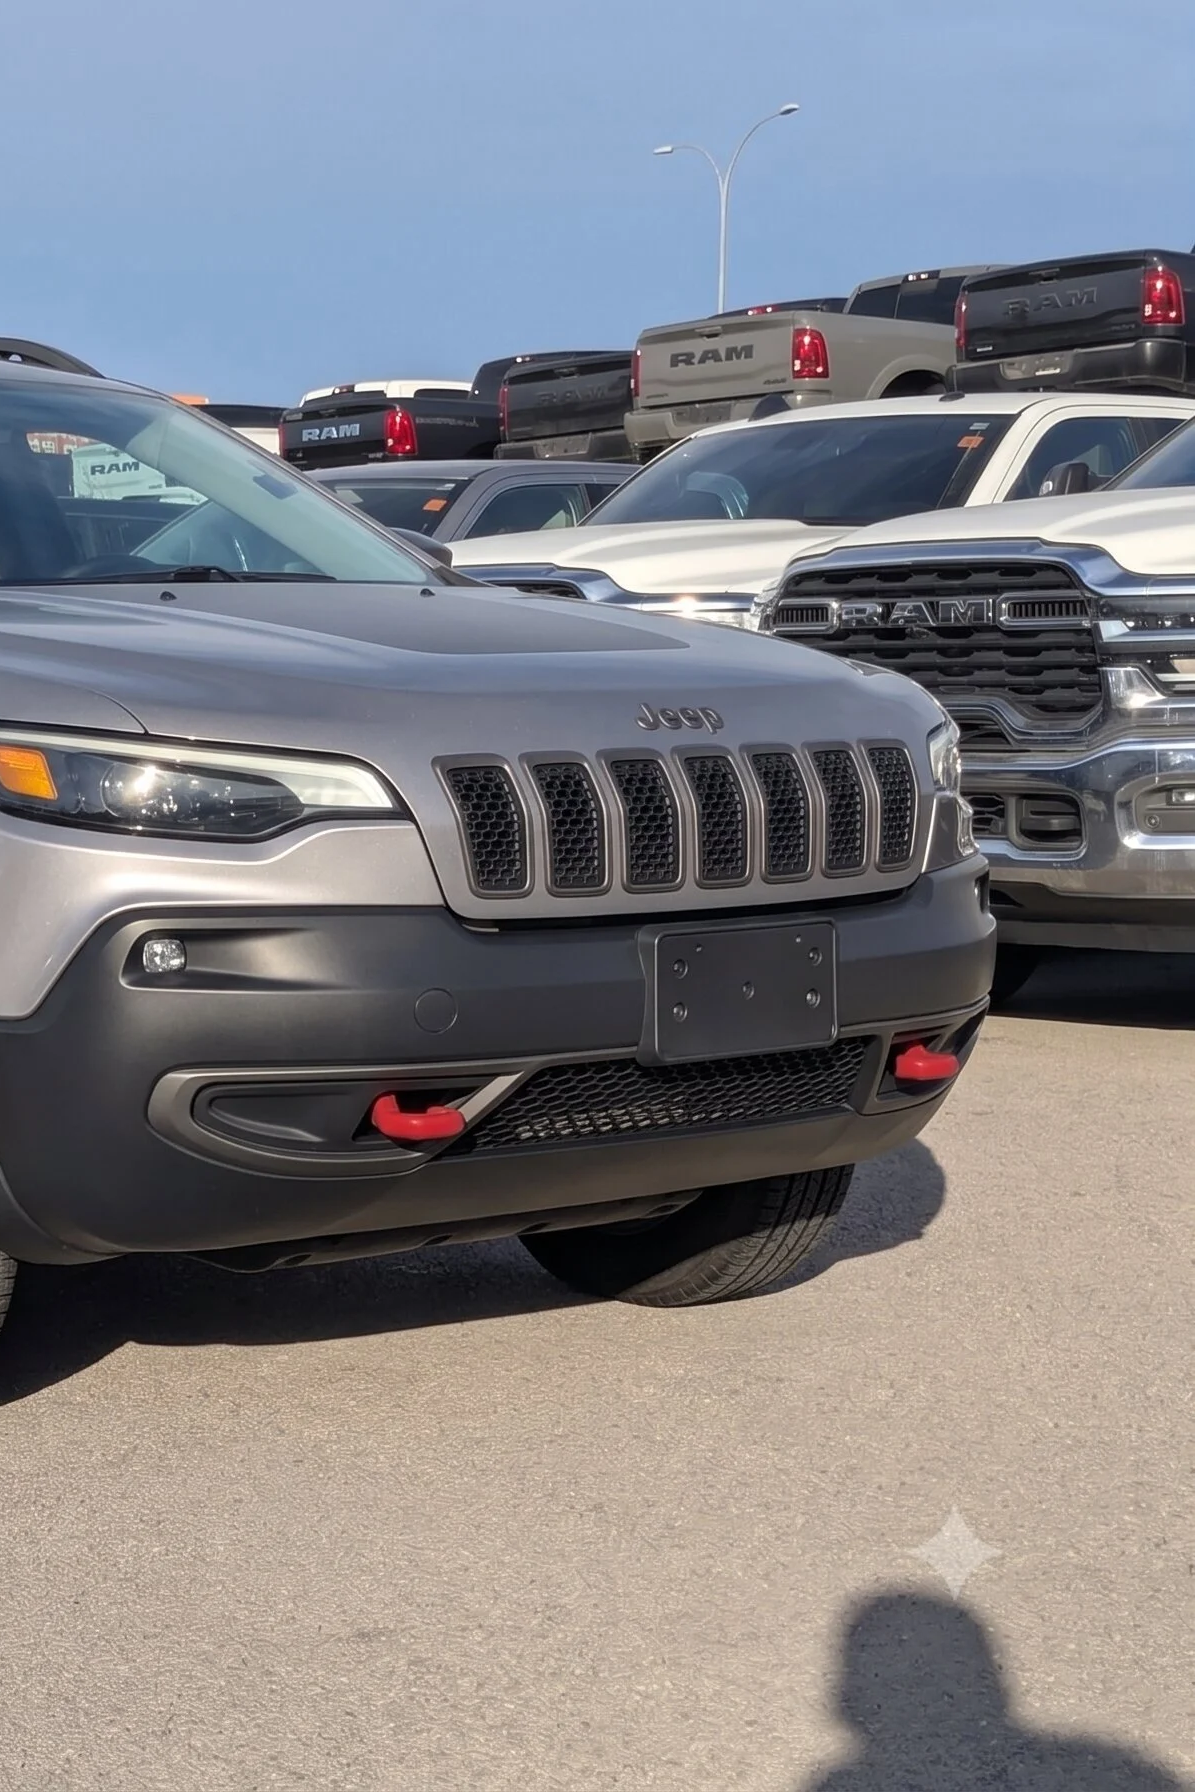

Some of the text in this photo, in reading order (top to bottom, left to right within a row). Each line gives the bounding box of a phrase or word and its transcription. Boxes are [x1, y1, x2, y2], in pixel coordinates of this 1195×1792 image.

[1003, 286, 1098, 315] RAM
[670, 343, 755, 368] RAM
[302, 423, 360, 442] RAM
[90, 461, 140, 476] RAM
[839, 599, 993, 628] RAM
[635, 702, 725, 735] Jeep
